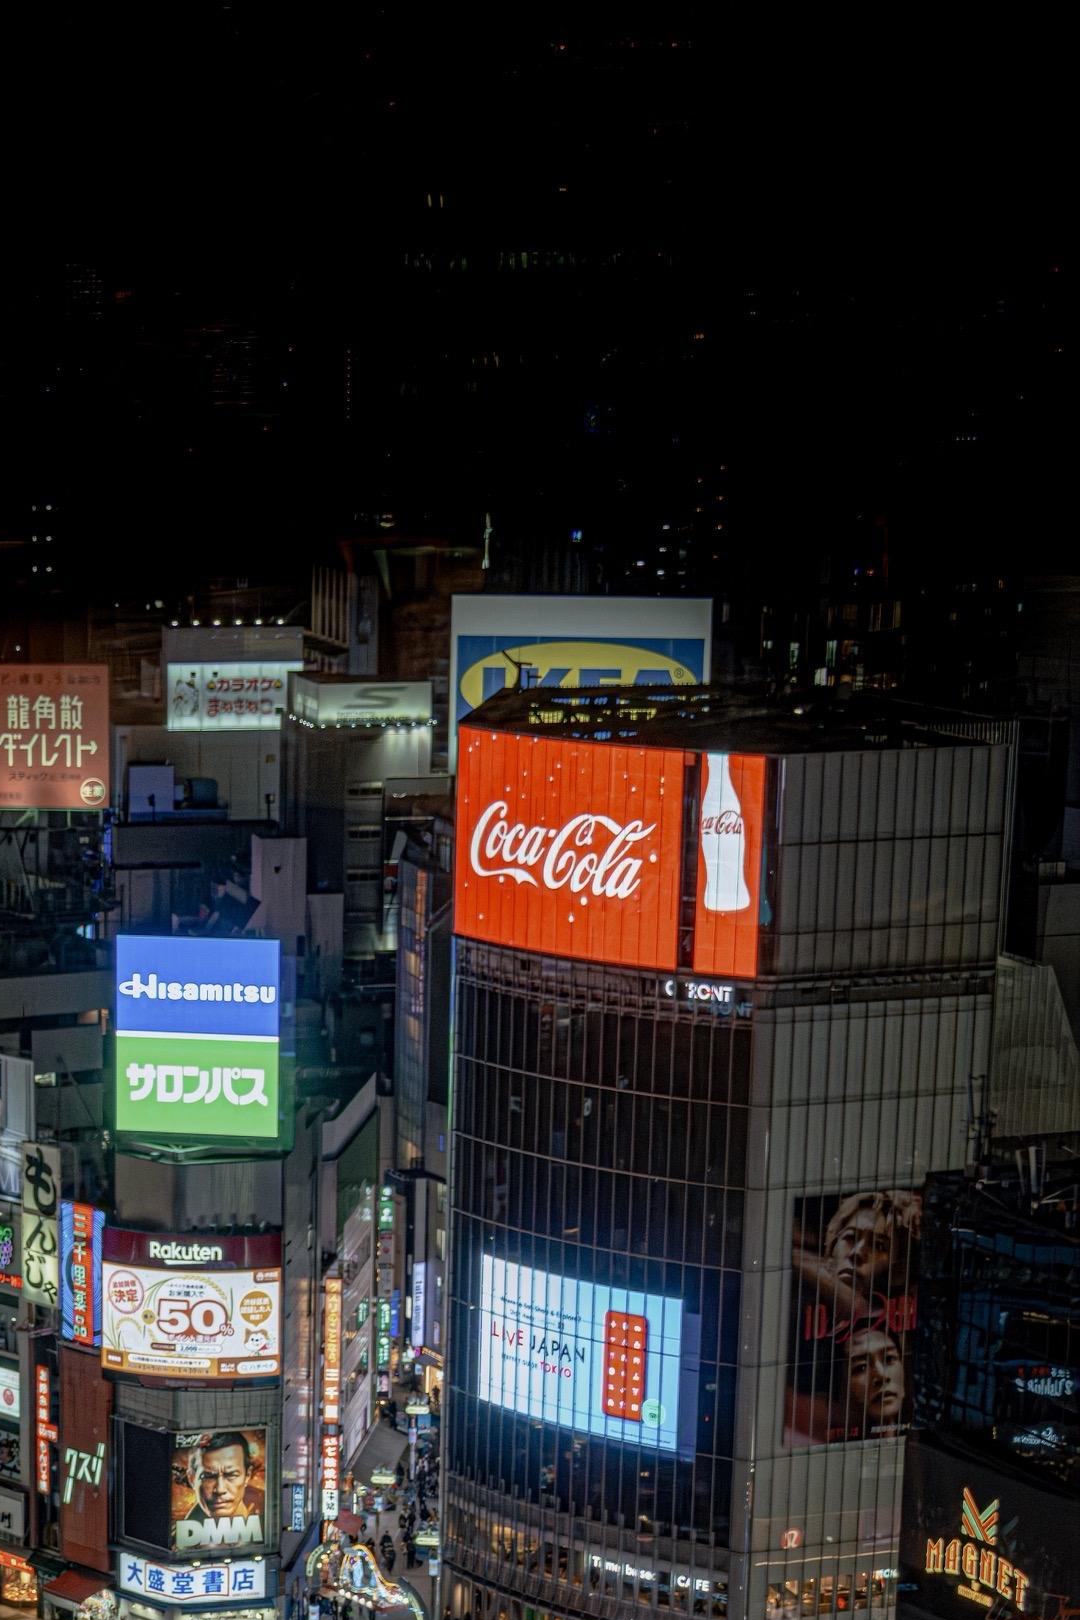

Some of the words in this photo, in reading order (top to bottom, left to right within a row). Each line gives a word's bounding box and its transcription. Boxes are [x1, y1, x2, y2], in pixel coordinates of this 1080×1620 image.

[216, 678, 274, 692] カラオケ
[7, 694, 84, 730] 龍角散
[207, 698, 273, 717] まねきねこ
[470, 800, 656, 899] Coca-Cola
[119, 973, 276, 1003] Hisamitsu
[126, 1062, 268, 1107] サロンパス
[149, 1241, 222, 1261] Rakuten
[113, 1289, 139, 1303] 決定
[157, 1298, 235, 1337] 50%
[491, 1321, 524, 1347] LIVE
[530, 1335, 585, 1364] JAPAN
[540, 1361, 571, 1378] TOKYO
[63, 1443, 105, 1504] クスリ
[176, 1514, 263, 1548] DMM
[127, 1561, 255, 1594] 大盛堂書店
[925, 1538, 1030, 1611] MAGNET
